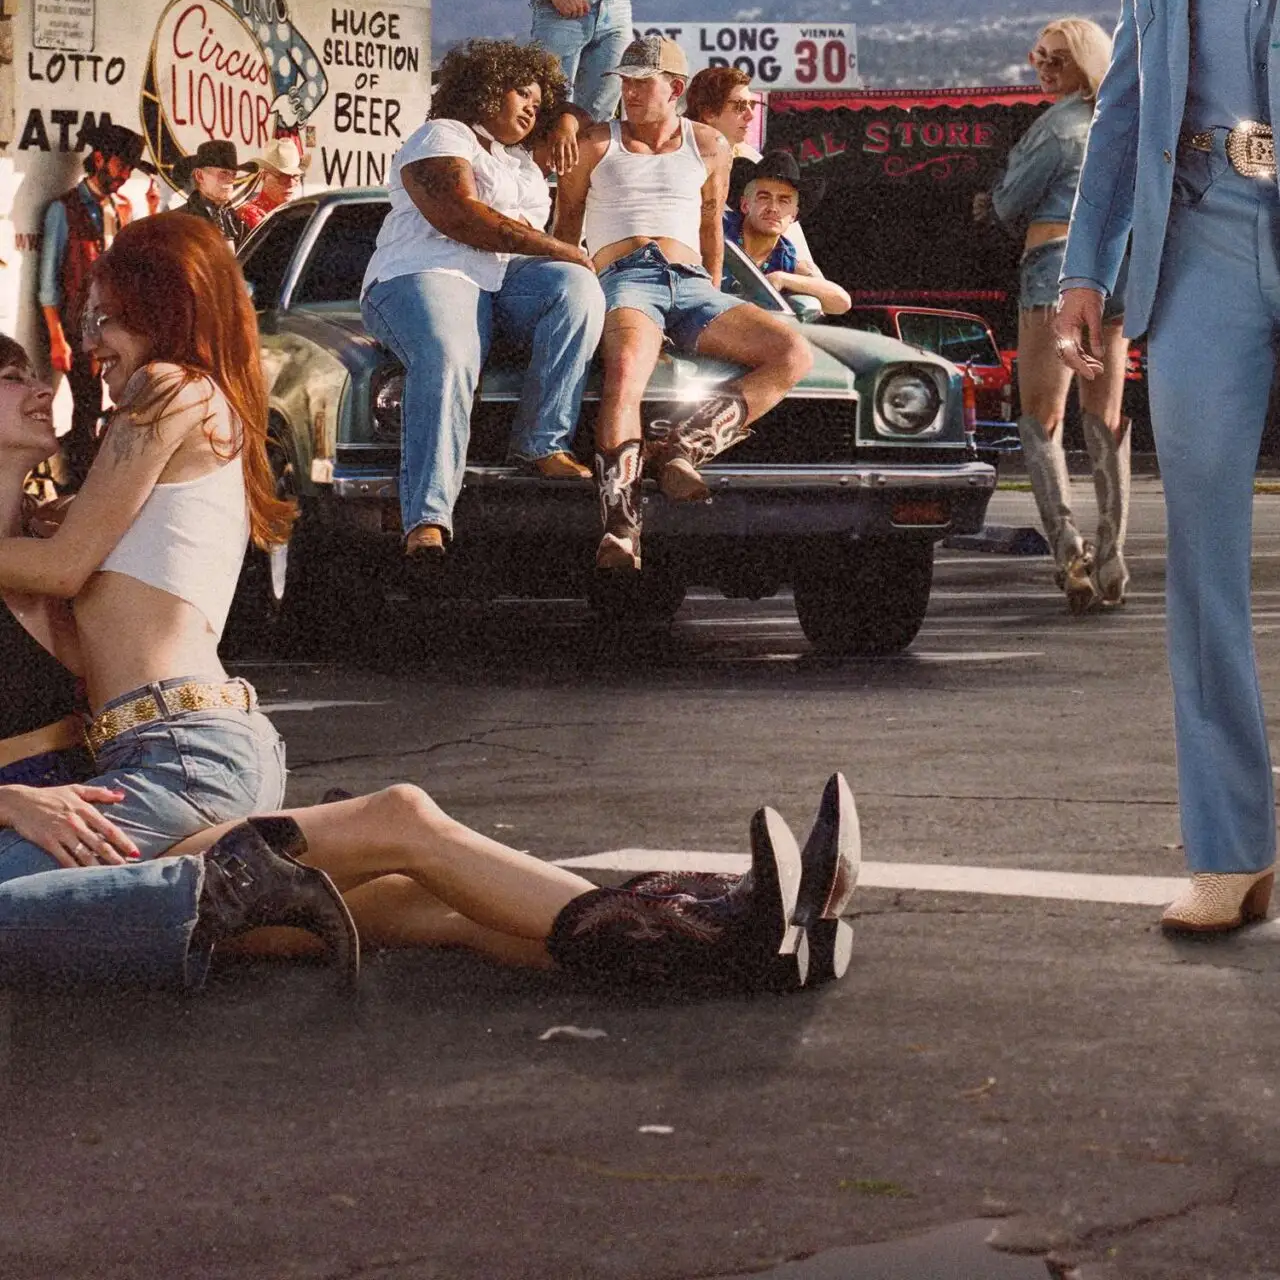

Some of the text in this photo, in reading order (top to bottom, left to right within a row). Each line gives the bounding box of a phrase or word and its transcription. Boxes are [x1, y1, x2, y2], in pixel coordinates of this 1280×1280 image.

[331, 8, 401, 40] HUGE
[700, 28, 779, 52] LONG
[800, 29, 845, 39] VIENNA
[173, 4, 269, 85] Circus
[323, 39, 419, 72] SELECTION
[28, 51, 126, 85] LOTTO
[354, 72, 380, 90] OF
[172, 64, 270, 148] LIQUOR
[334, 92, 401, 137] BEER
[863, 121, 993, 153] STORE
[321, 146, 396, 188] WIN
